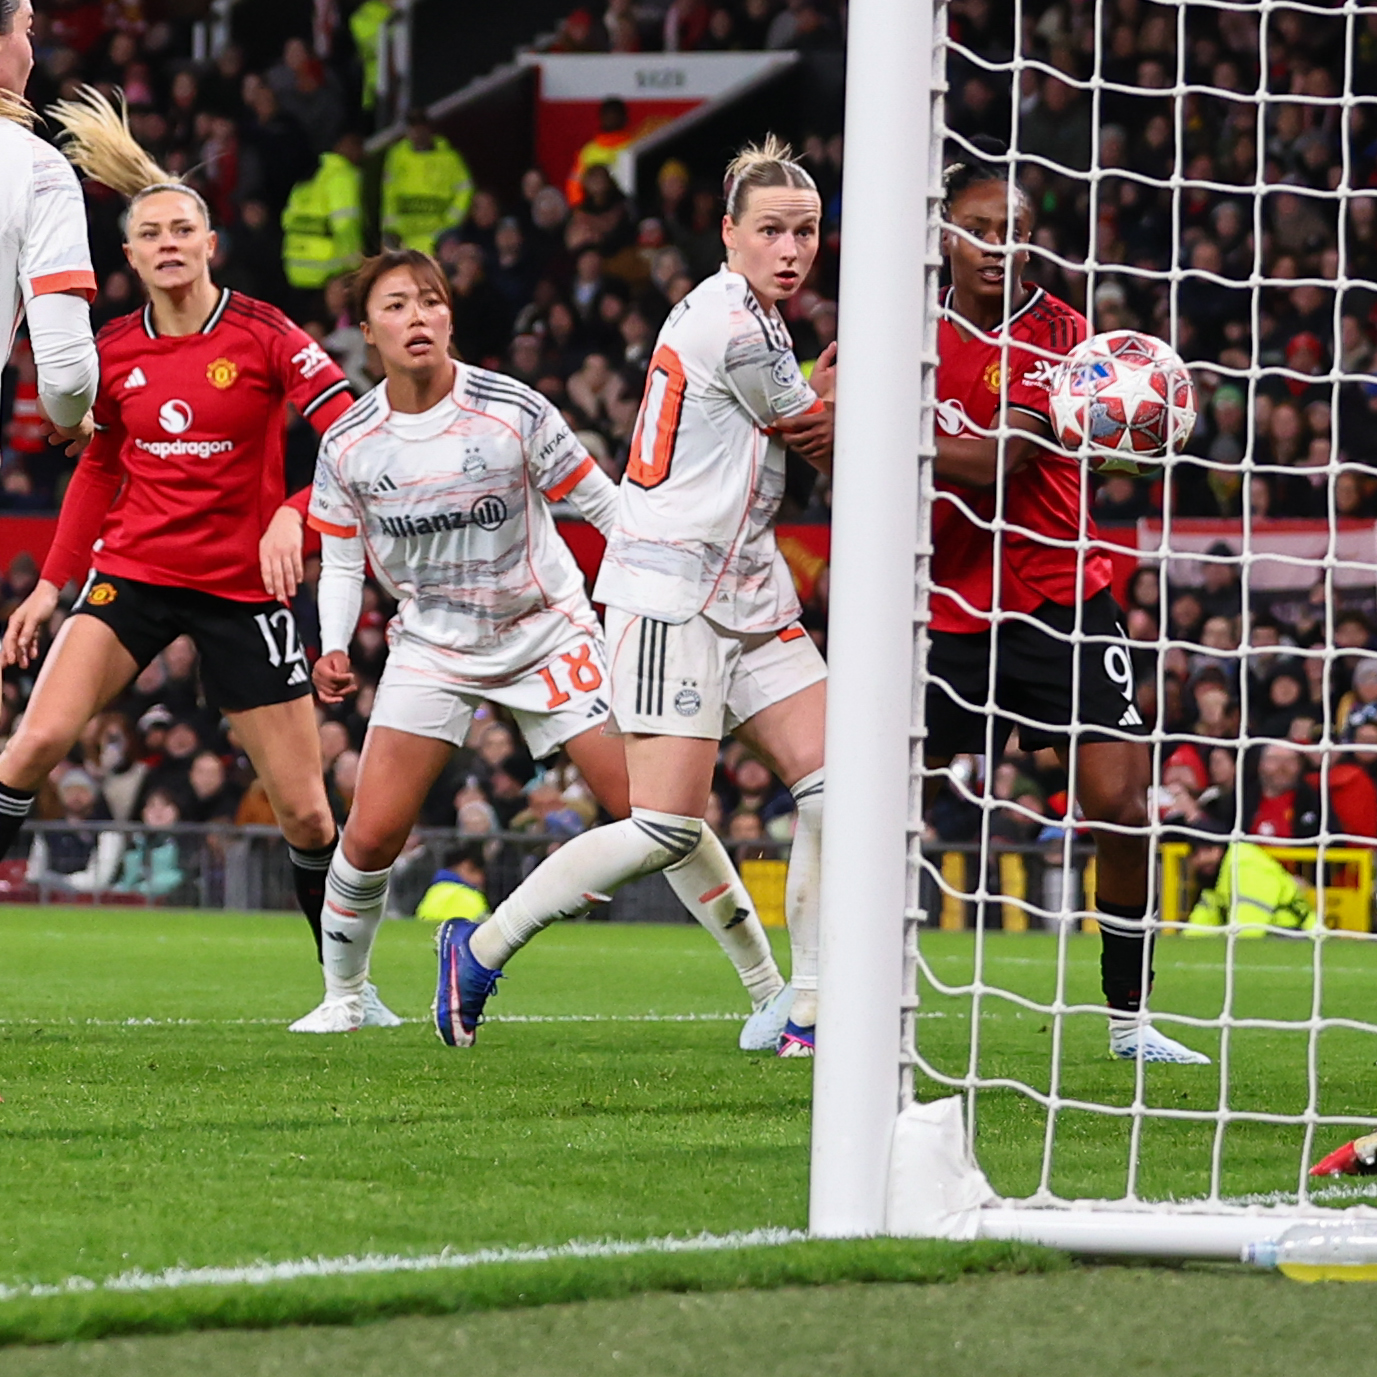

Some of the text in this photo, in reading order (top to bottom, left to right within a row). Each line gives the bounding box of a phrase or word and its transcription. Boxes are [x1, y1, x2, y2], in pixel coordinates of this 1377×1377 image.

[134, 437, 234, 460] Snapdragon
[377, 510, 468, 539] Allianz
[253, 608, 304, 668] 12
[536, 643, 603, 710] 18
[1104, 645, 1133, 702] 9
